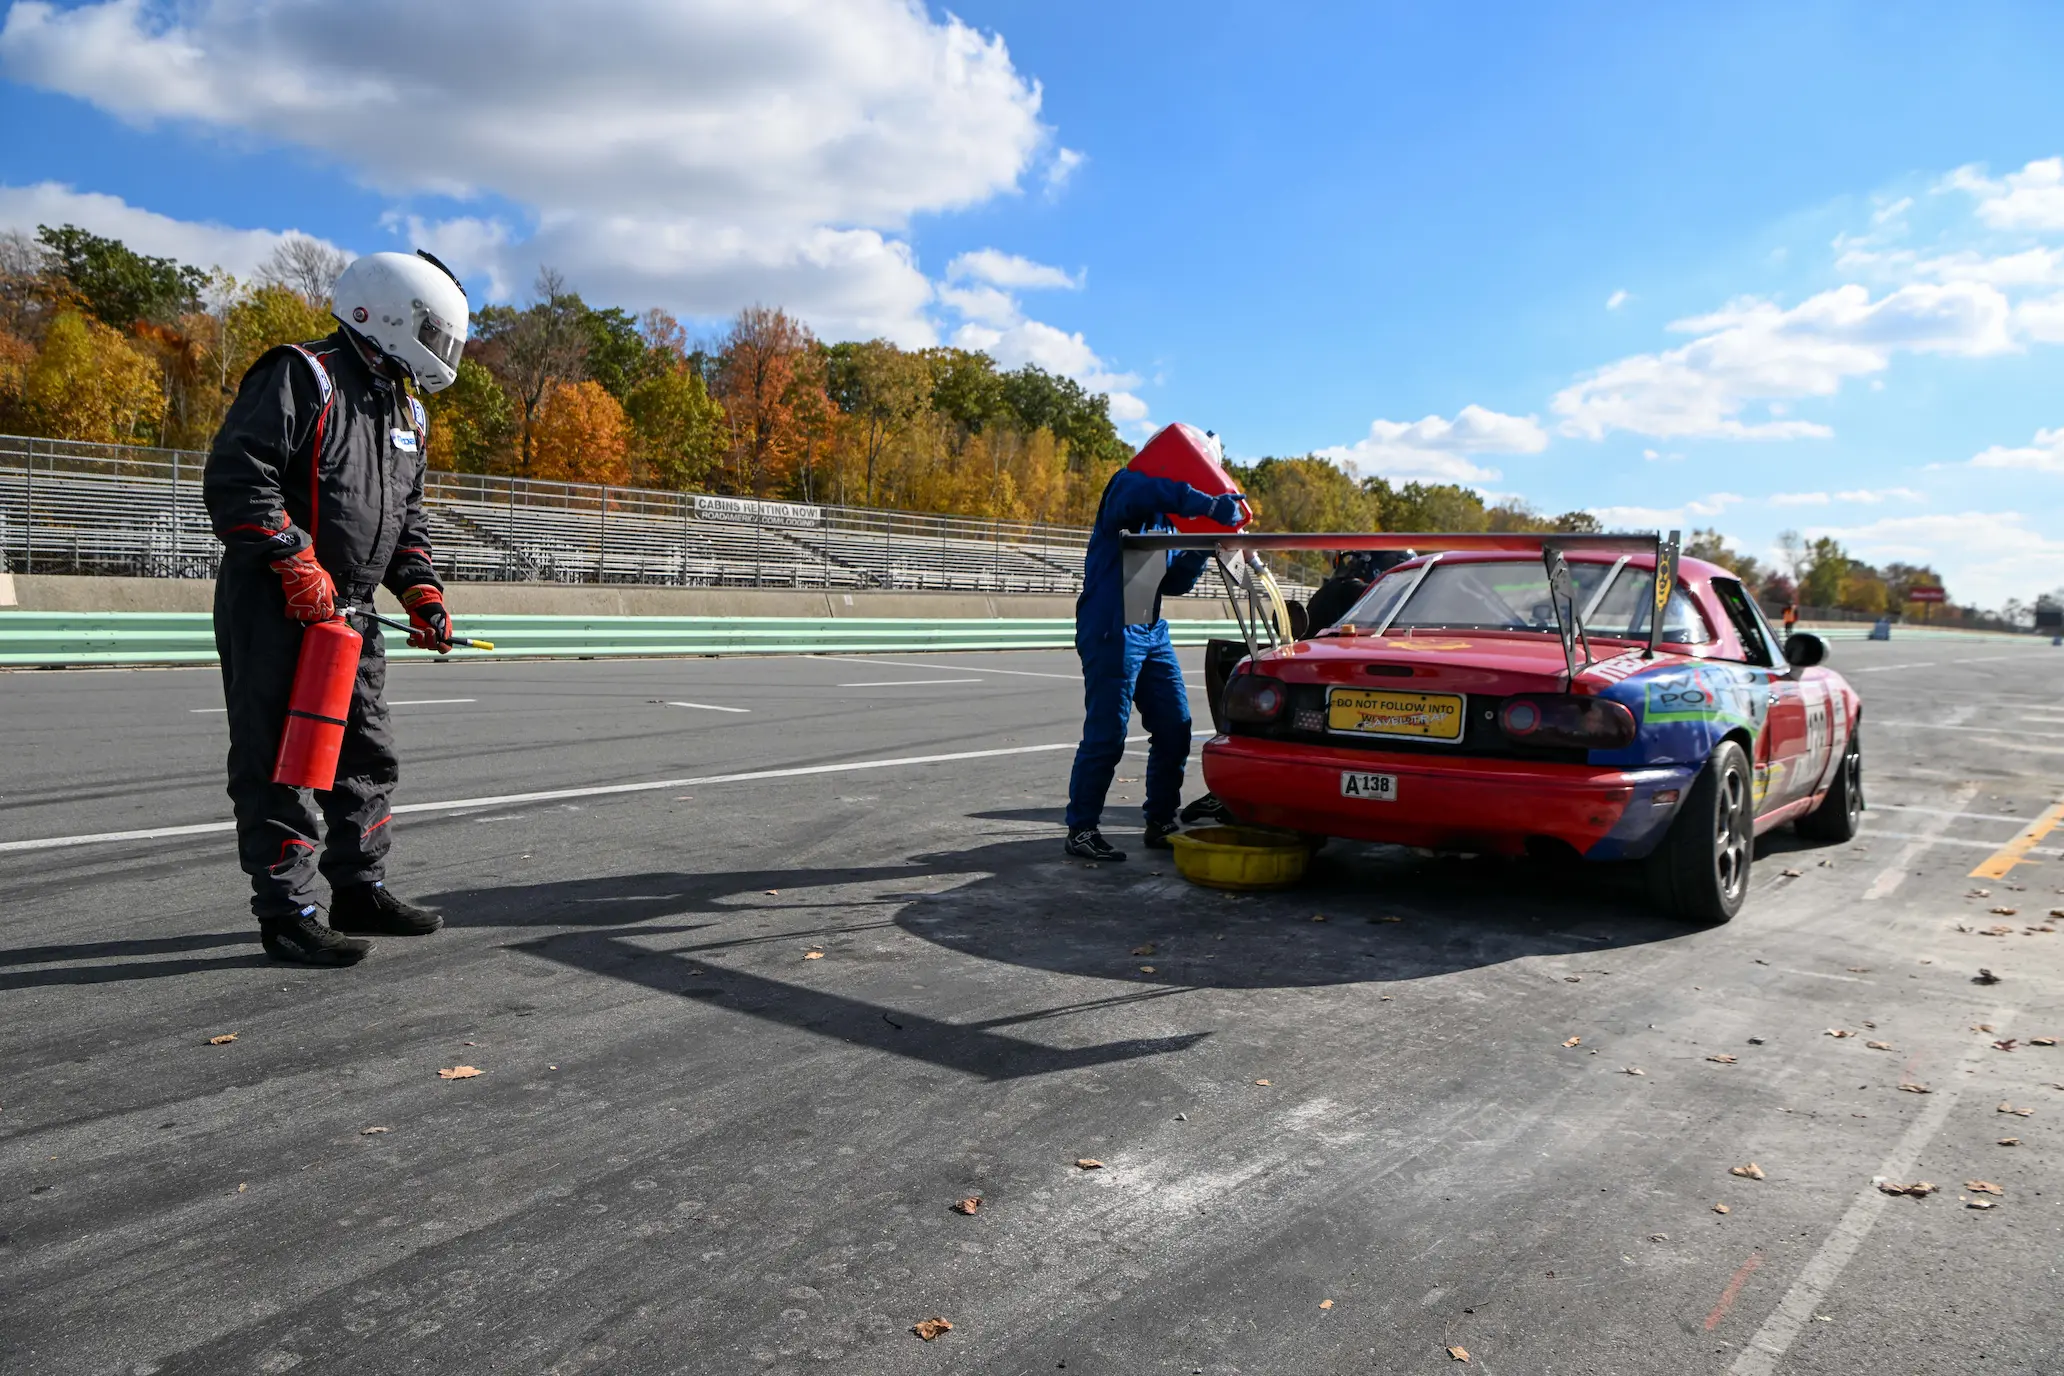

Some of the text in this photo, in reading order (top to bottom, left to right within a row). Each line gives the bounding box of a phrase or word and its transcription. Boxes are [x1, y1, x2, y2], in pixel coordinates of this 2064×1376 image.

[698, 498, 818, 518] CABINS RENTING NOW!
[1337, 698, 1454, 715] DO NOT FOLLOW INTO
